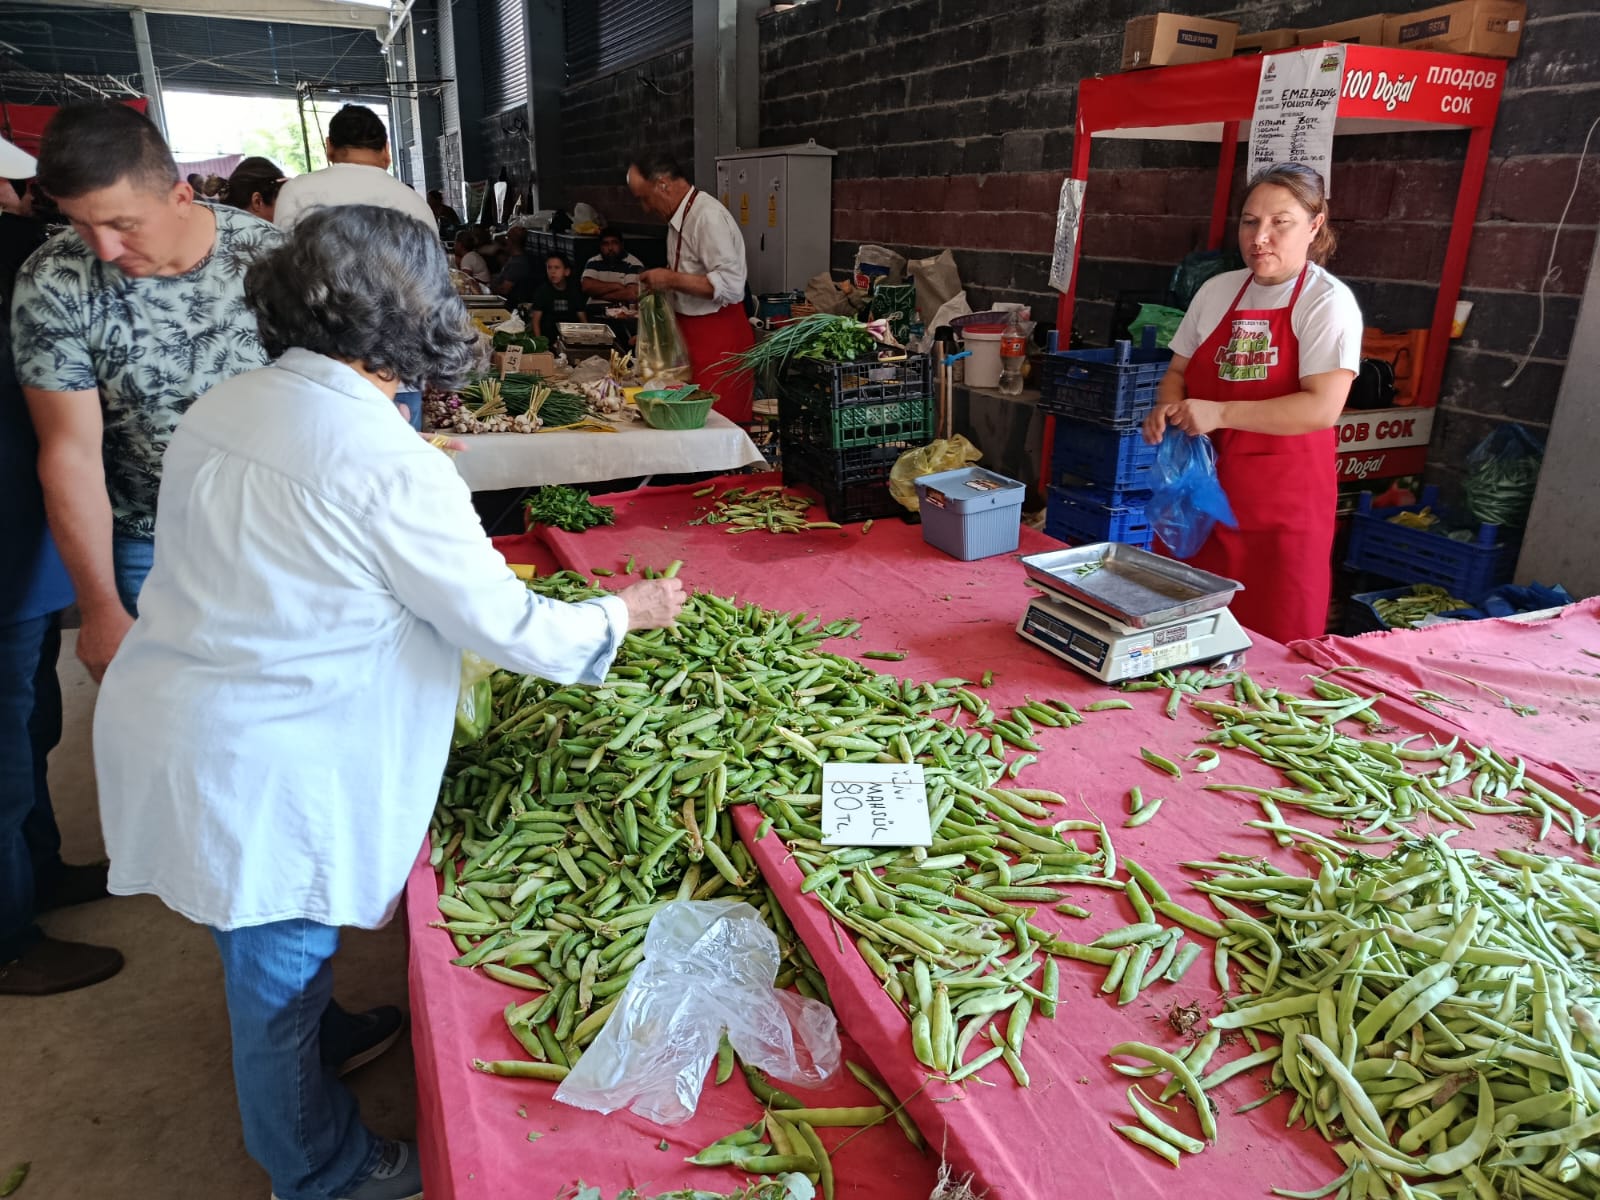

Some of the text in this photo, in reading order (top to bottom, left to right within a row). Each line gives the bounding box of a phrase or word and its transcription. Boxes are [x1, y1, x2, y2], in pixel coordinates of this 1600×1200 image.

[1342, 69, 1418, 111] 100 Doğal
[1426, 66, 1497, 90] ПЛОДОВ
[1440, 95, 1473, 114] СОК
[1375, 418, 1416, 440] СОК
[1344, 454, 1387, 479] Doğal
[830, 781, 863, 811] 80
[865, 781, 895, 840] MAHSÜL
